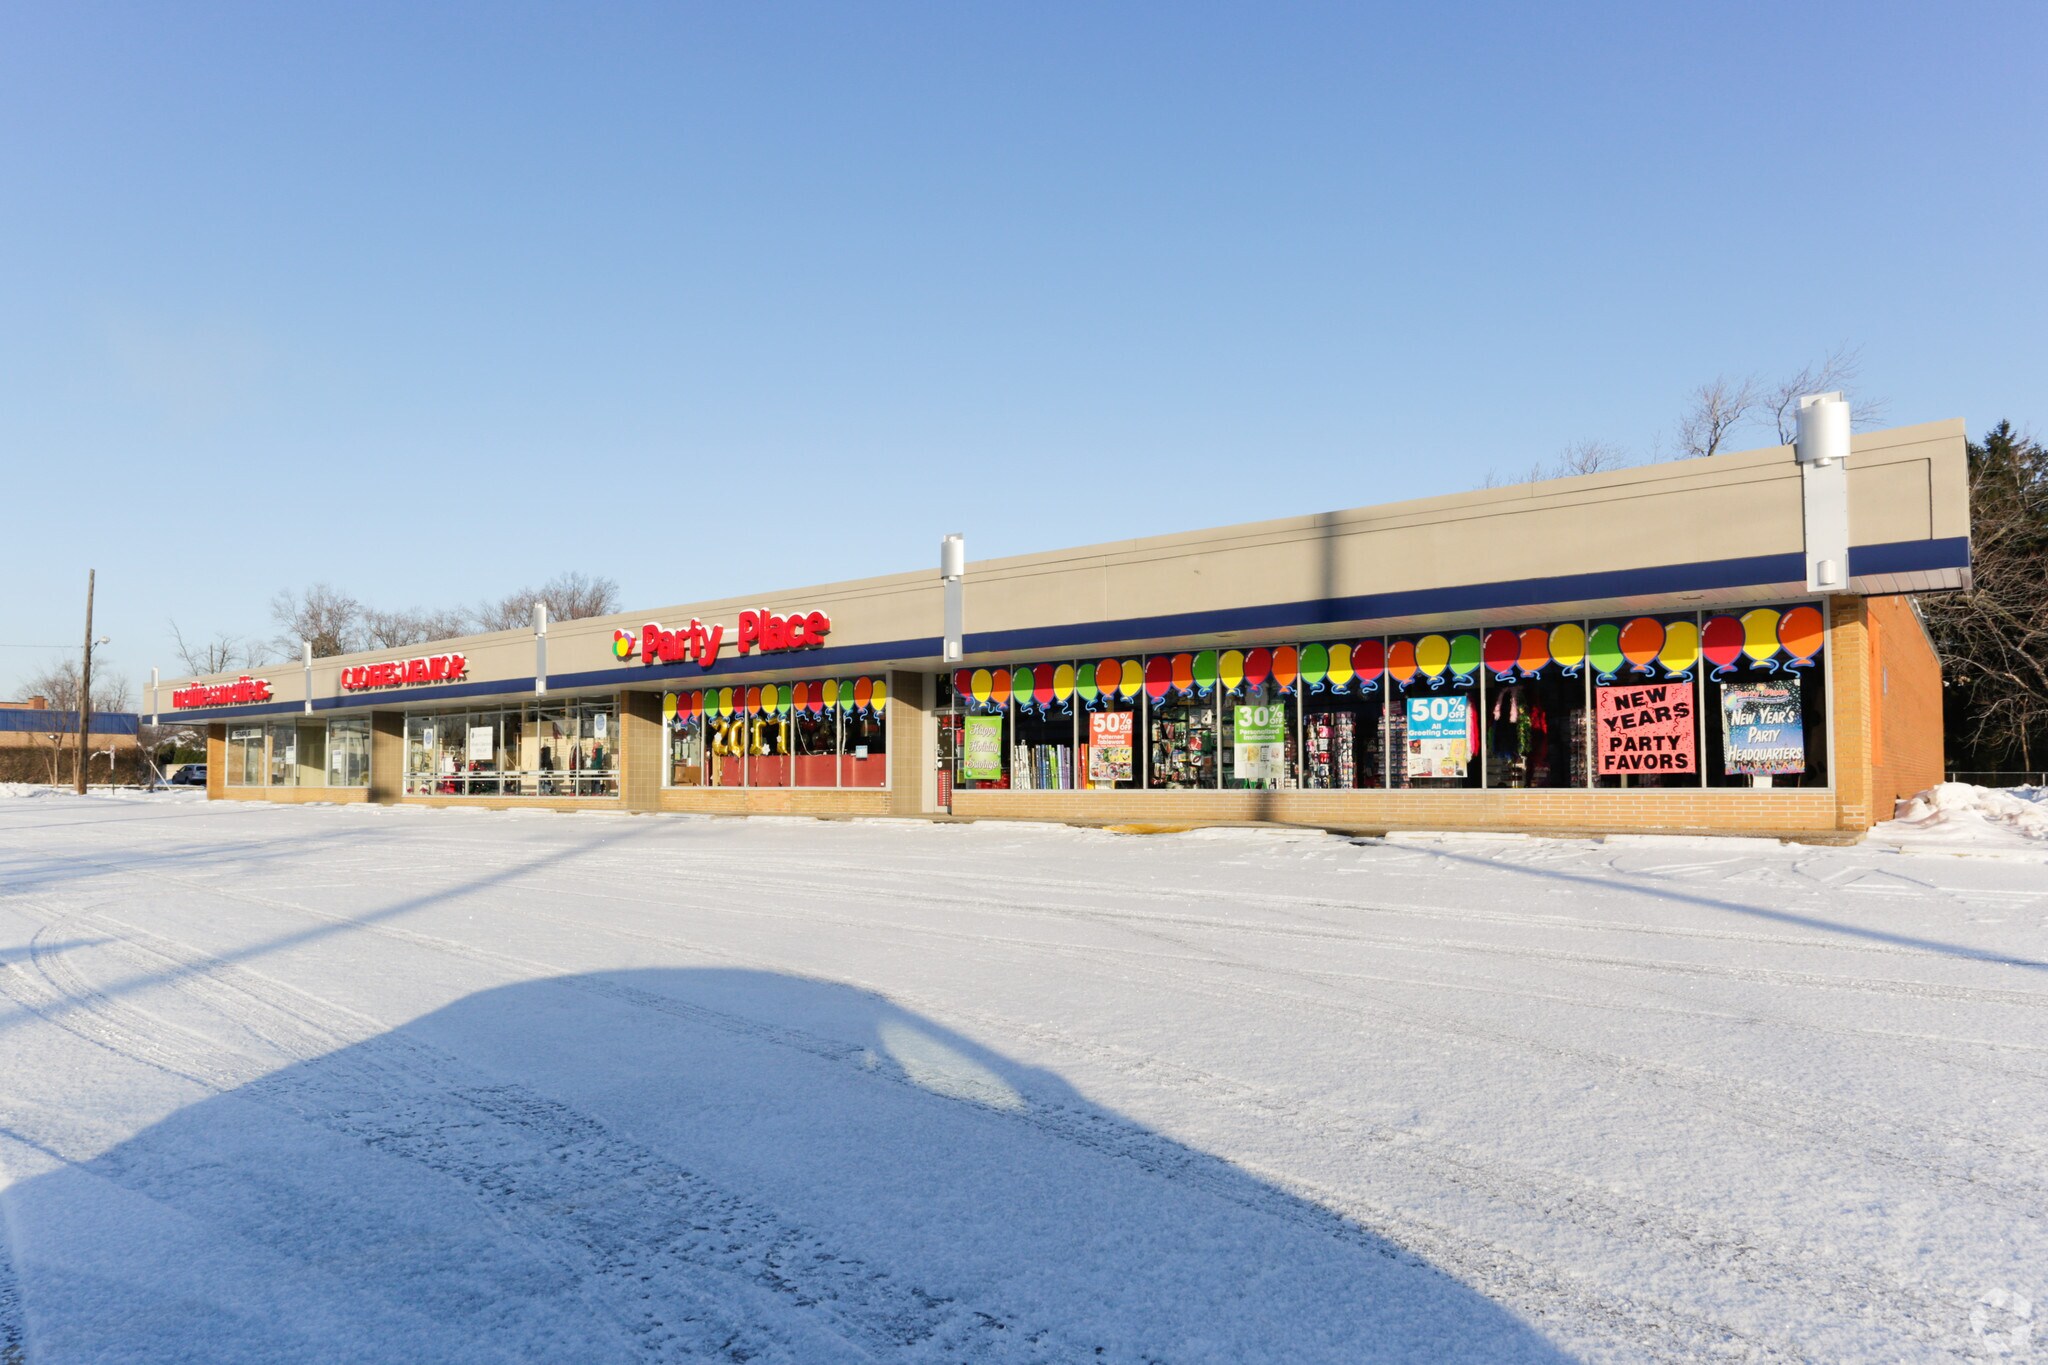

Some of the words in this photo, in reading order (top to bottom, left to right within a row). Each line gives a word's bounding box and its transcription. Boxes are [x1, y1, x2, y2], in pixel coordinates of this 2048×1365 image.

[641, 618, 723, 667] Party
[738, 607, 831, 653] Place
[341, 660, 402, 690] CLOTHES
[401, 652, 467, 683] MENTOR
[1614, 686, 1667, 711] NEW
[1269, 717, 1283, 725] OFF
[1448, 711, 1465, 719] OFF
[1603, 702, 1690, 732] YEARS
[969, 723, 997, 738] Happy
[1408, 729, 1441, 737] Greeting
[968, 740, 999, 753] Holiday
[1610, 735, 1681, 752] PARTY
[967, 759, 999, 770] Savings
[1605, 753, 1688, 770] FAVORS
